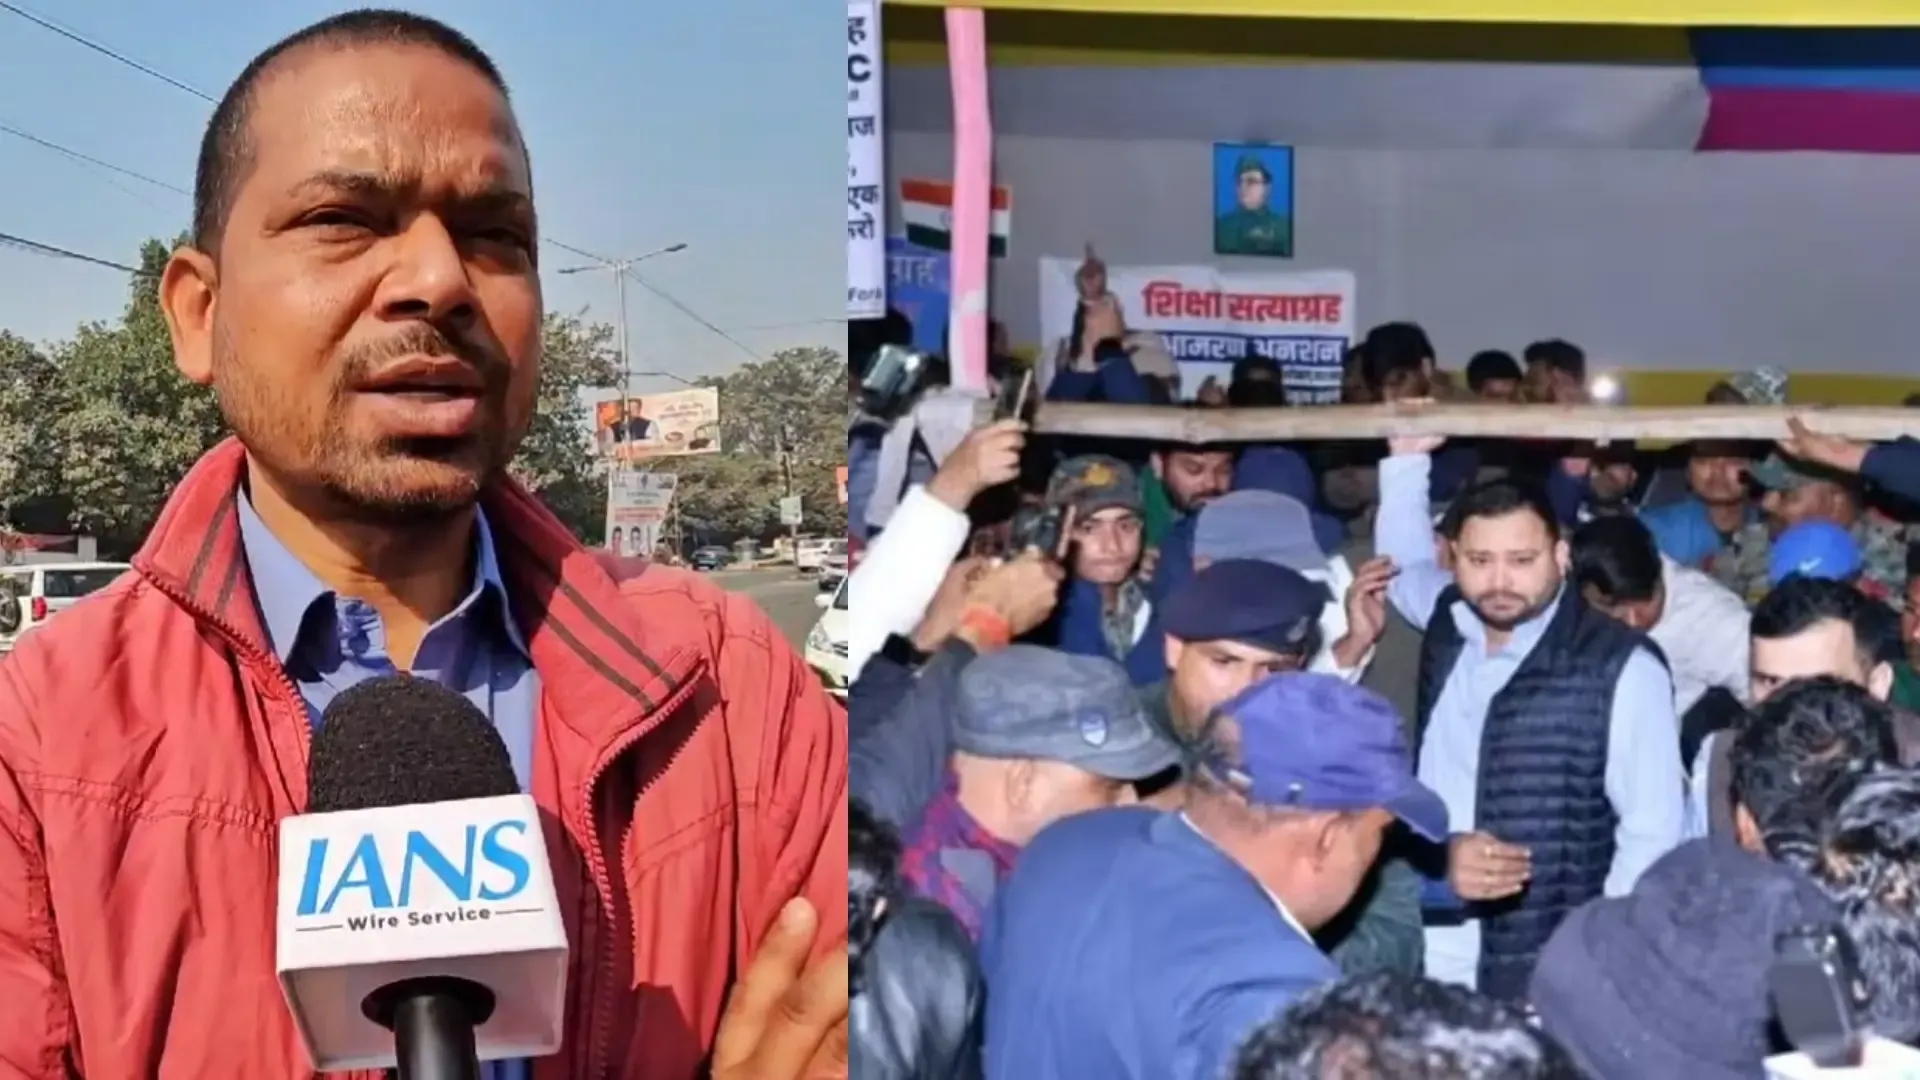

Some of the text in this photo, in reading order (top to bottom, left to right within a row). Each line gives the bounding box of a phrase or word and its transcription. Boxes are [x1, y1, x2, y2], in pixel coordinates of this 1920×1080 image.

[1141, 280, 1343, 323] शिक्षा सत्याग्रह
[296, 820, 530, 916] IANS
[348, 906, 491, 931] Wire Service
